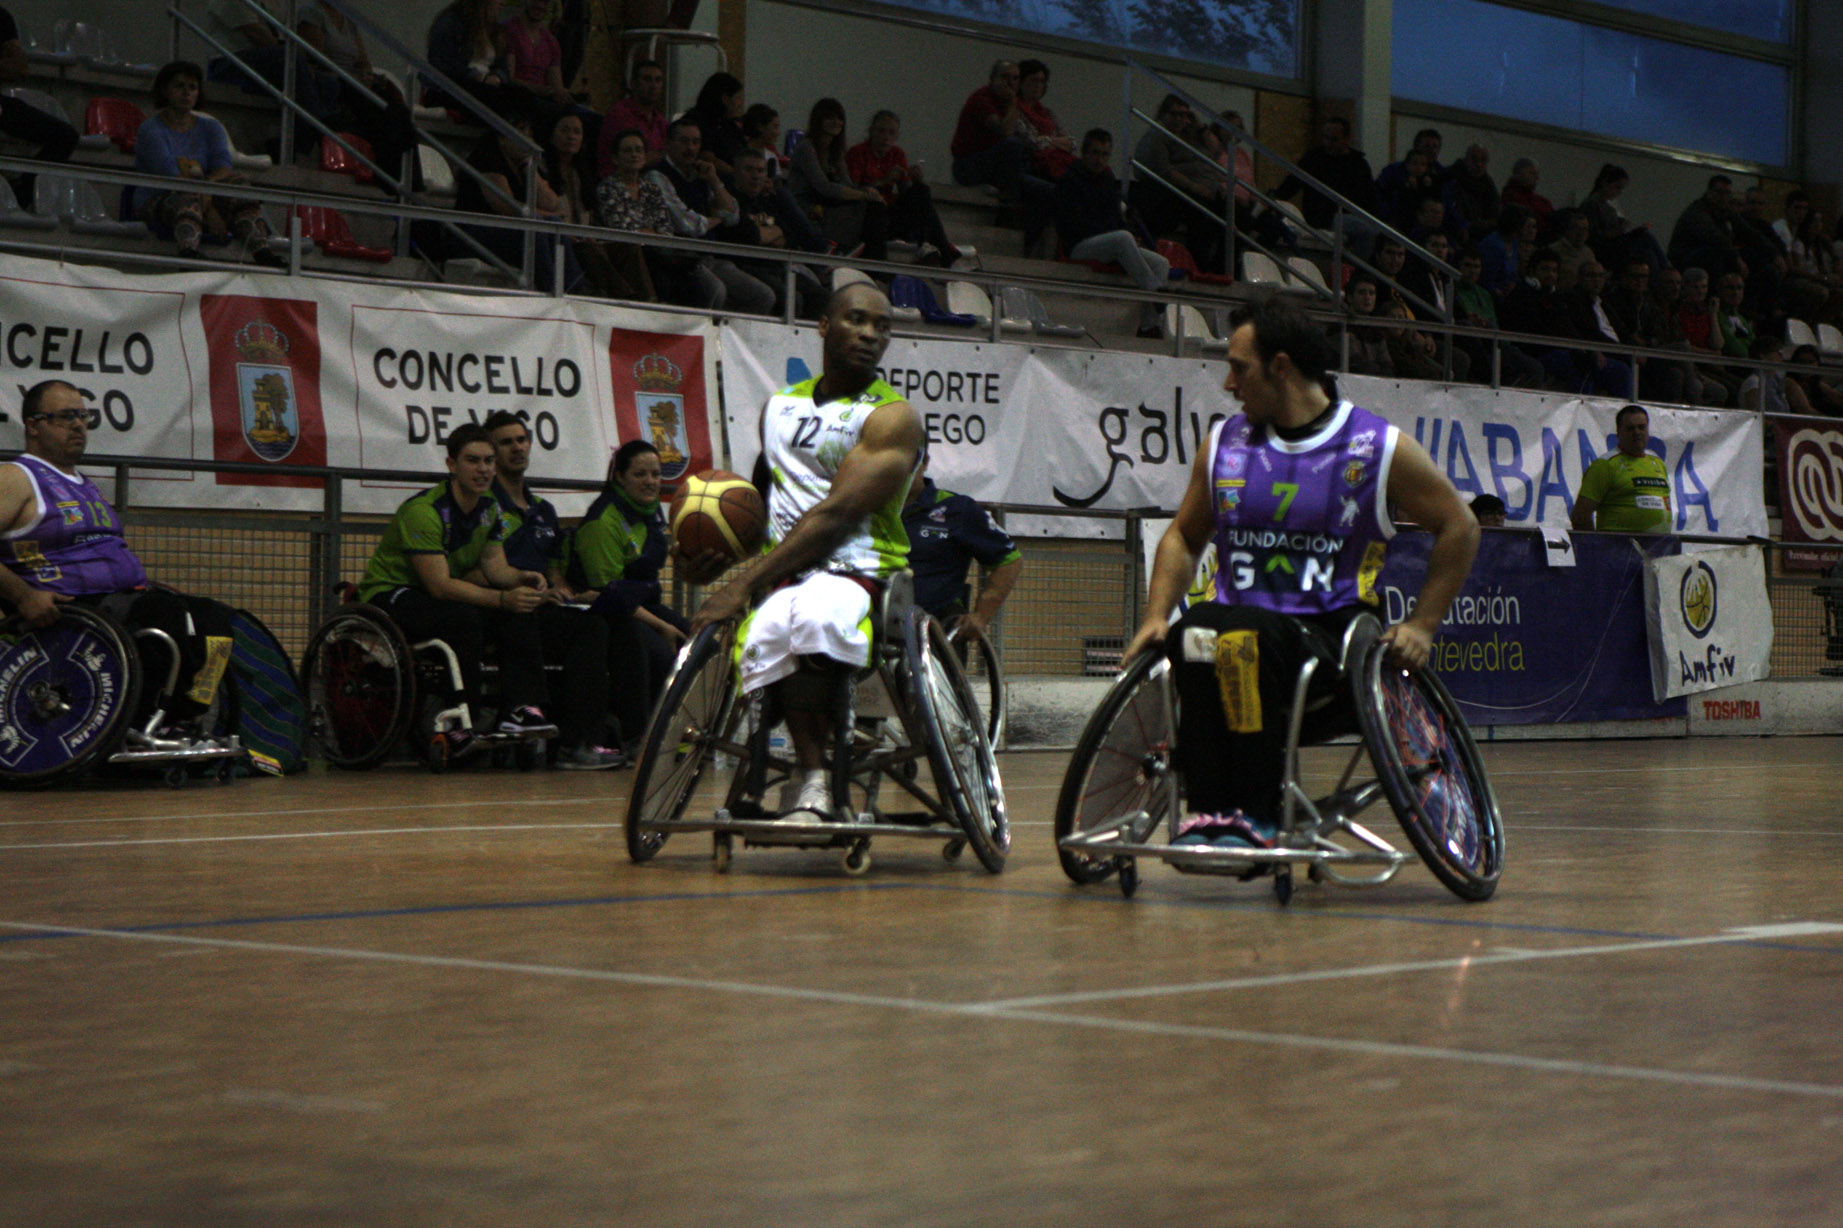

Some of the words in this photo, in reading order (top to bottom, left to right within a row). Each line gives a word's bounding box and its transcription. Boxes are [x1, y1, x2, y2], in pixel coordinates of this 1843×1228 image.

[0, 321, 155, 376] CELLO
[373, 347, 582, 398] CONCELLO
[405, 404, 452, 446] DE
[791, 416, 823, 448] 12
[86, 500, 113, 528] 13
[1272, 482, 1299, 522] 7
[1229, 531, 1344, 553] FUNDACIÓN
[1679, 644, 1736, 687] Amfiv
[70, 672, 115, 749] MICHELIN
[1703, 700, 1762, 721] TOSHIBA
